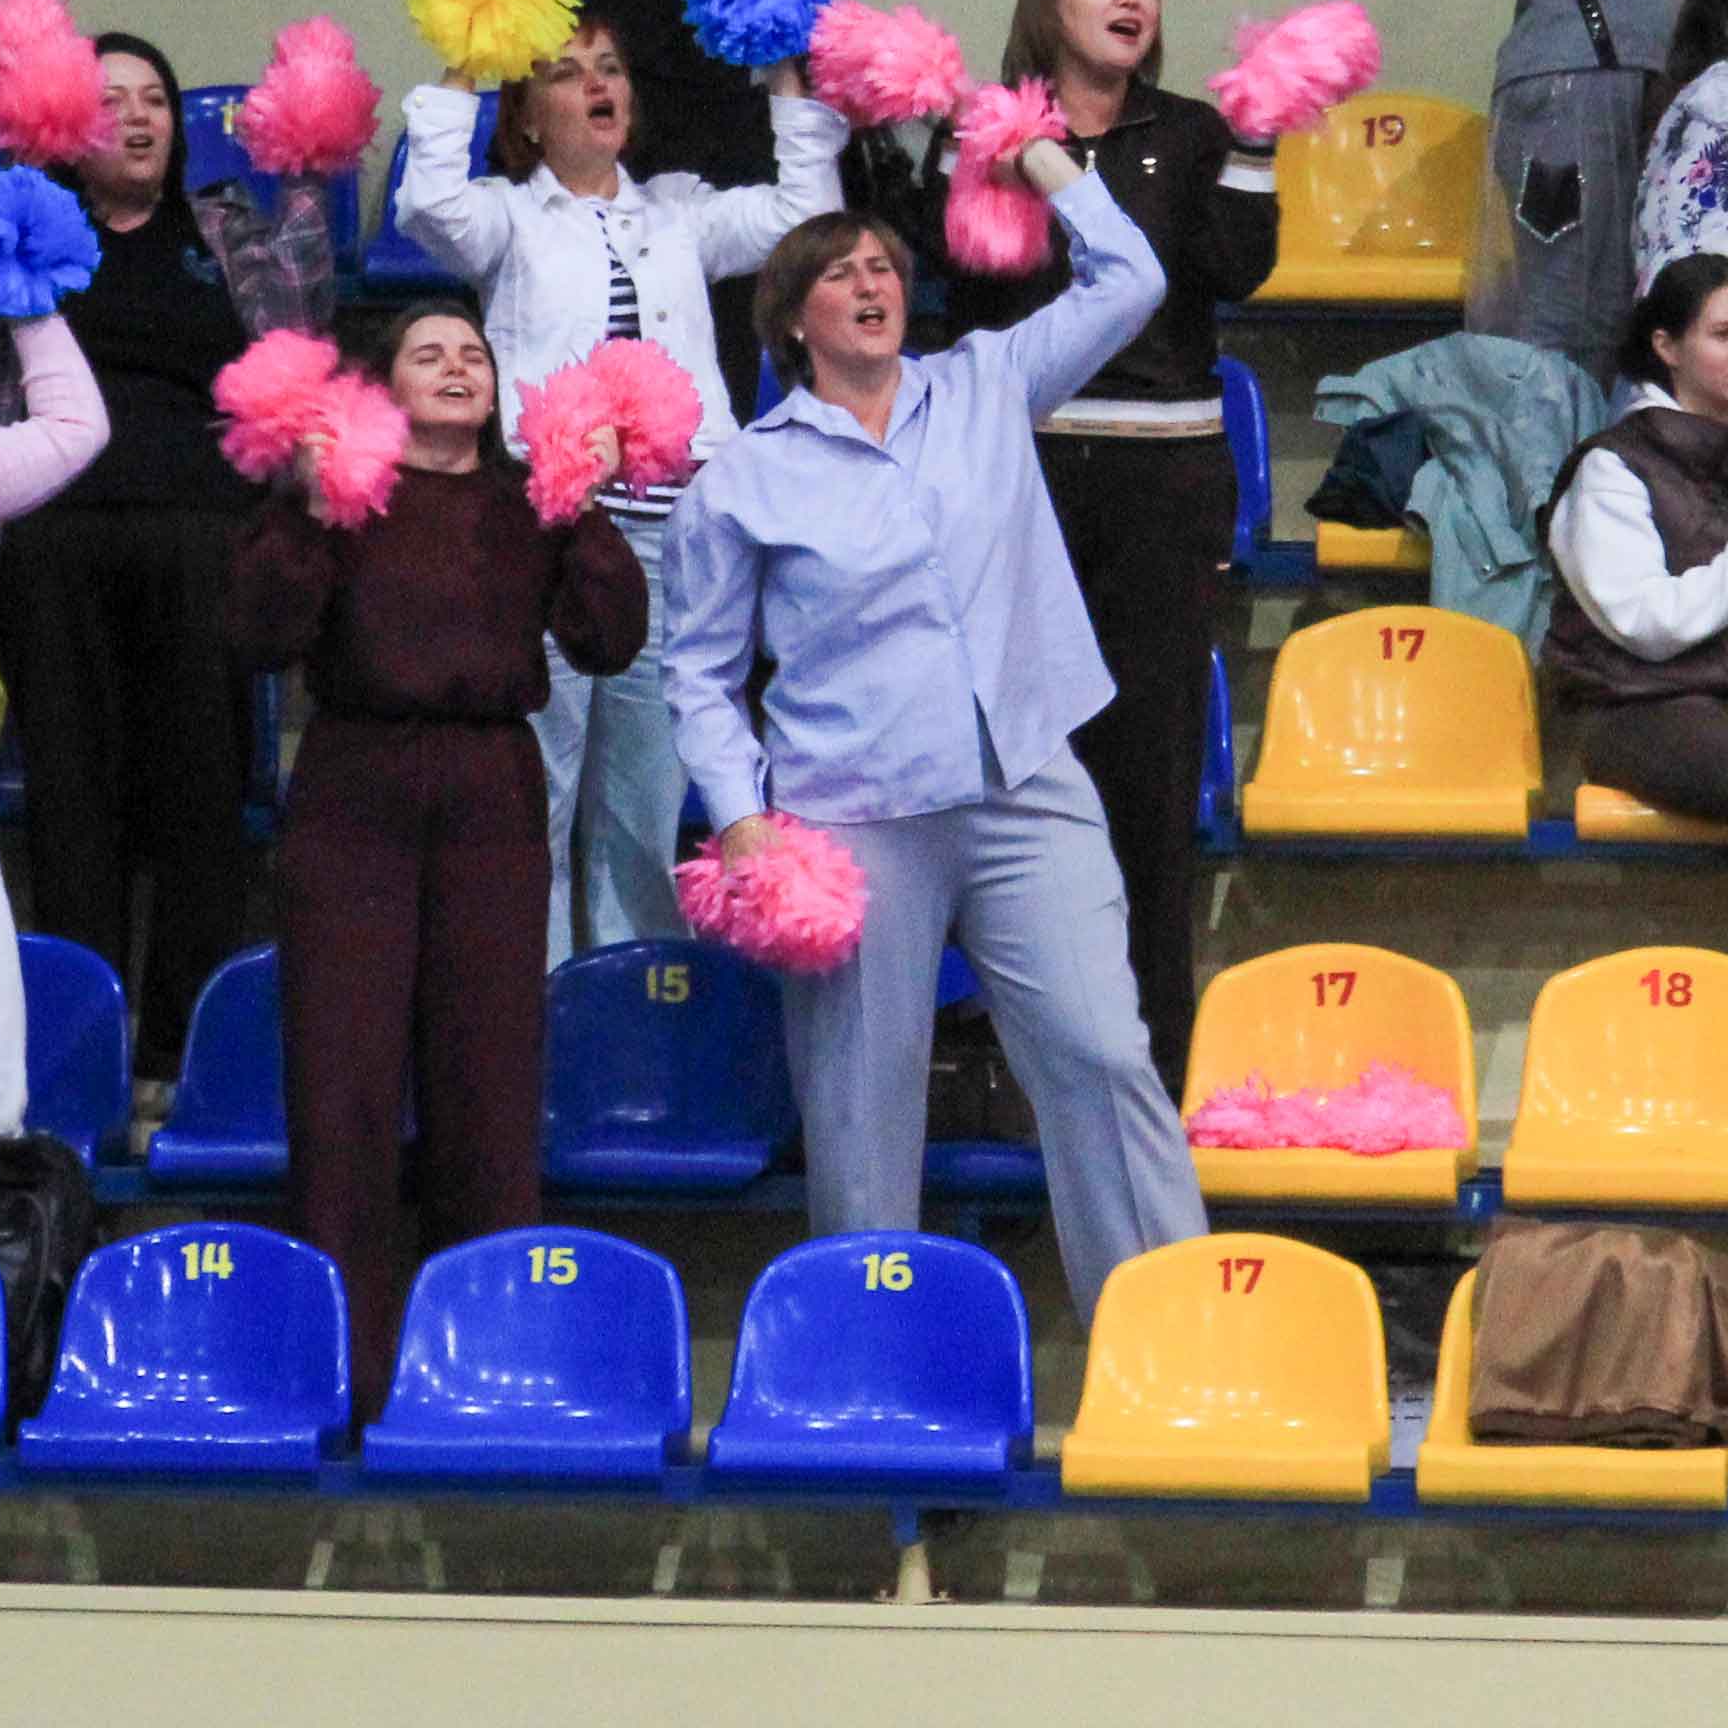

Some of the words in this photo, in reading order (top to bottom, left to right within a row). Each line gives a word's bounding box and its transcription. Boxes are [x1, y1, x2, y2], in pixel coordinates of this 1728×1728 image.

[1362, 114, 1406, 148] 19
[1379, 627, 1426, 662] 17
[646, 965, 690, 1004] 15
[1312, 971, 1357, 1007] 17
[1640, 969, 1693, 1008] 18
[181, 1242, 234, 1280] 14
[528, 1246, 579, 1285] 15
[863, 1252, 913, 1291] 16
[1218, 1257, 1265, 1294] 17
